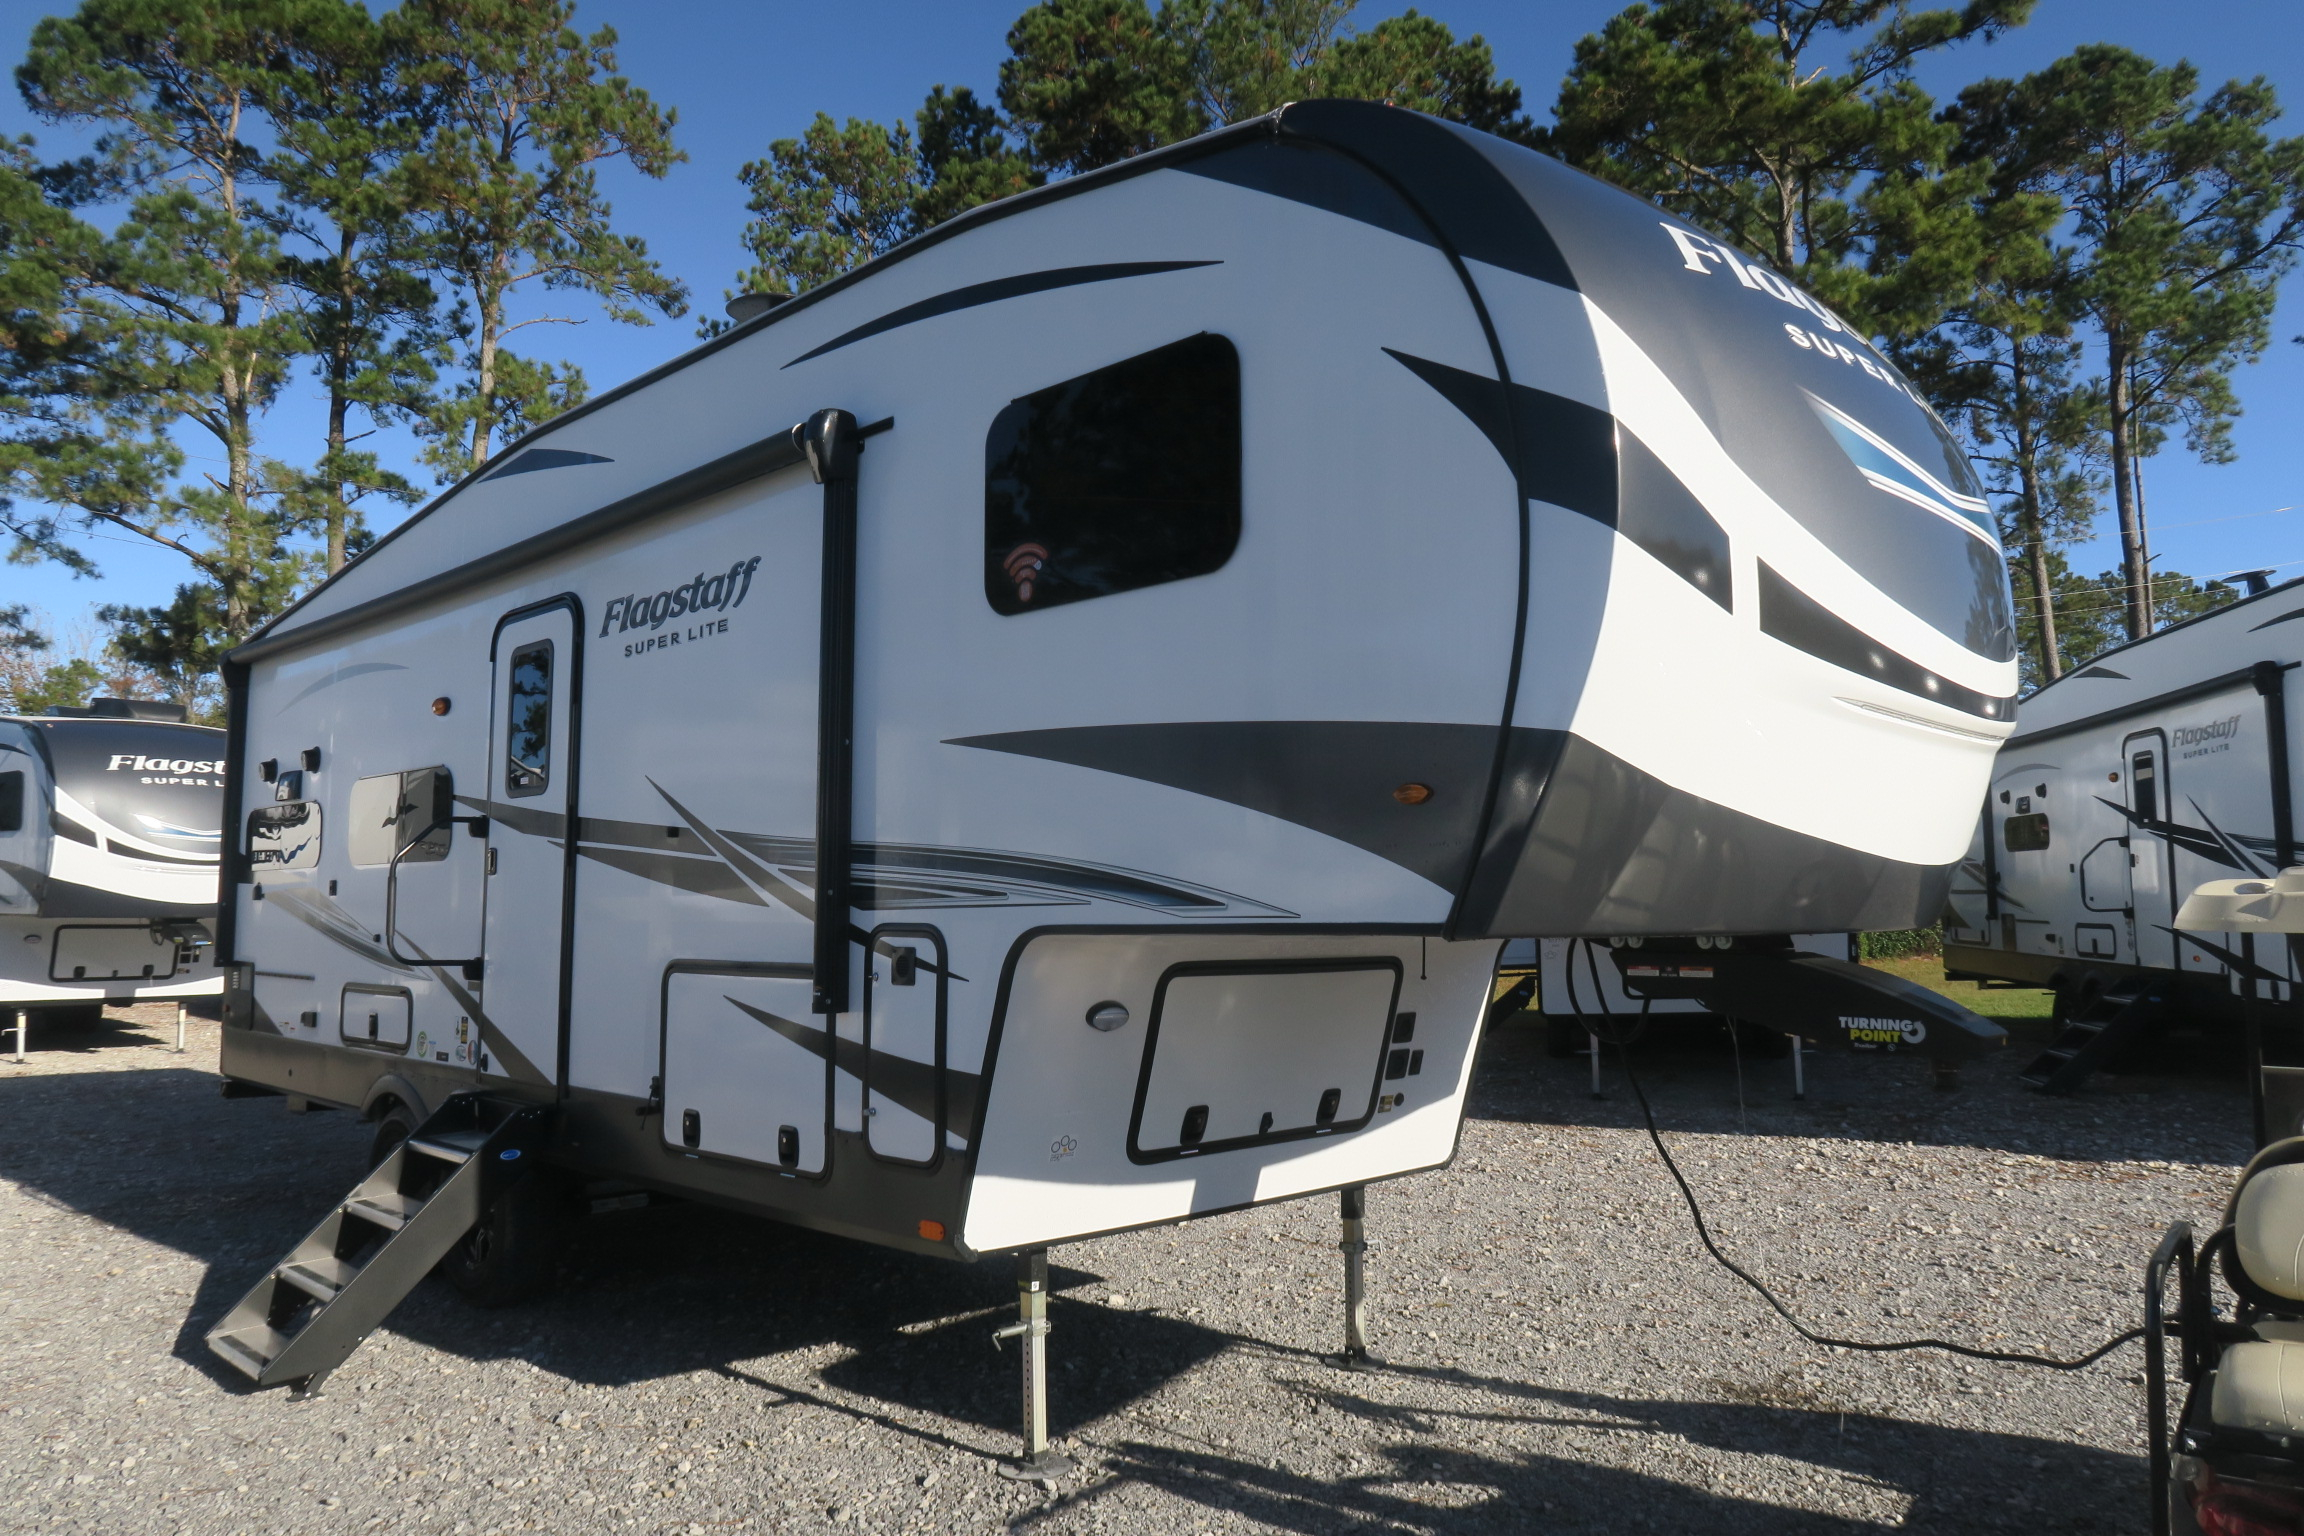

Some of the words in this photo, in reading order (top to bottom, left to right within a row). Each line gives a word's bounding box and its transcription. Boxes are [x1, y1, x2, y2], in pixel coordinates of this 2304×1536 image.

[1784, 322, 1903, 393] SUPER
[599, 555, 762, 638] Flagstaff
[624, 632, 681, 658] SUPER
[688, 618, 729, 641] LITE
[2172, 714, 2242, 748] Flagstaff
[2183, 748, 2209, 759] SUPER
[2211, 743, 2230, 753] LITE
[106, 755, 226, 774] Flagst
[140, 777, 209, 786] SUPER
[1838, 1016, 1914, 1032] TURNING
[1850, 1029, 1901, 1043] POINT
